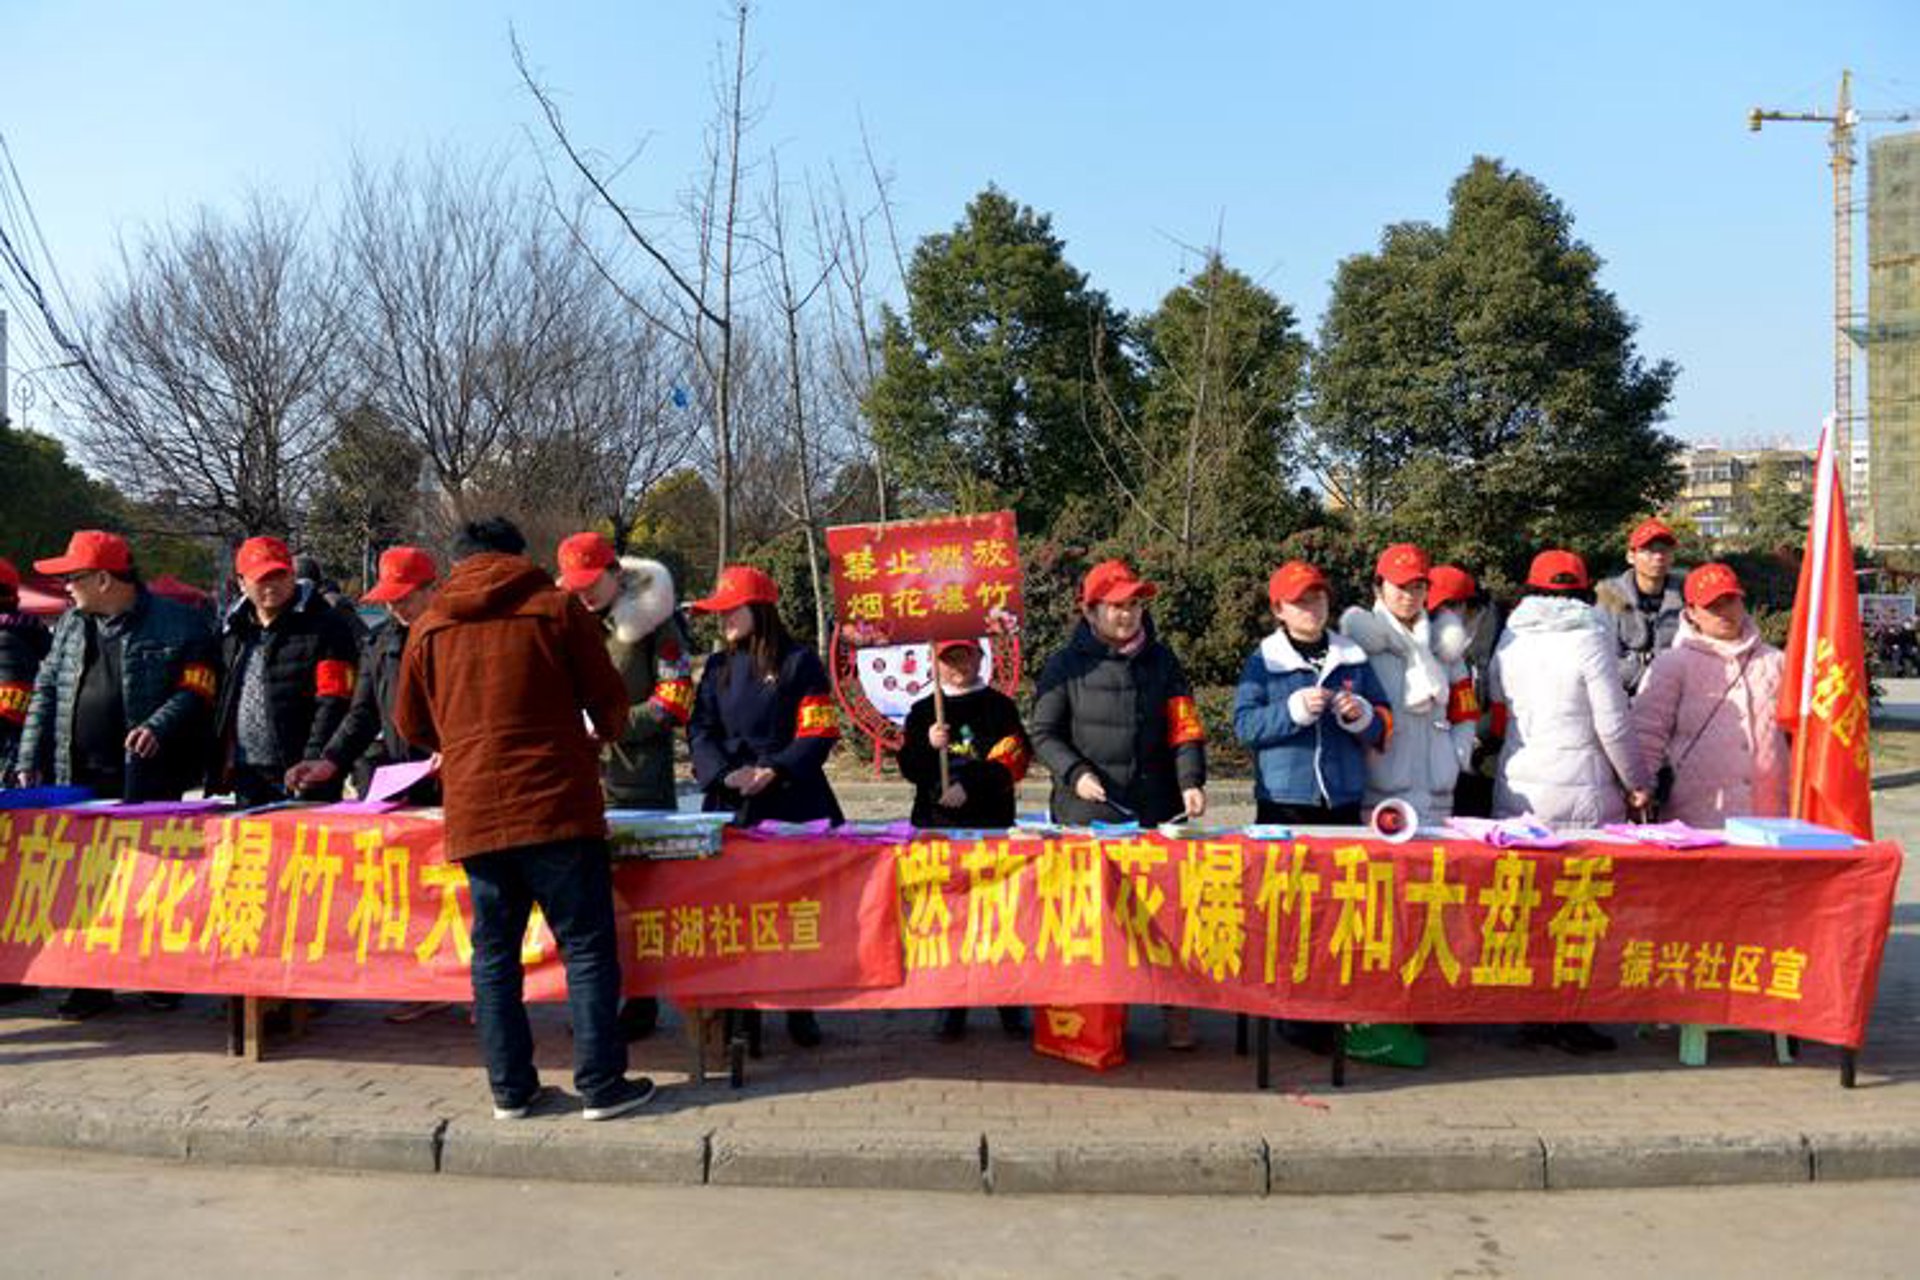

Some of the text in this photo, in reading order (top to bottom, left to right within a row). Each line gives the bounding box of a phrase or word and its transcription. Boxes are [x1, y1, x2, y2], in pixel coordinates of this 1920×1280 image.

[847, 581, 1013, 619] 烟花爆竹
[0, 813, 545, 965] 放烟花爆竹和大
[631, 899, 822, 960] 西湖社区宣
[1620, 940, 1808, 1000] 振兴社区宣
